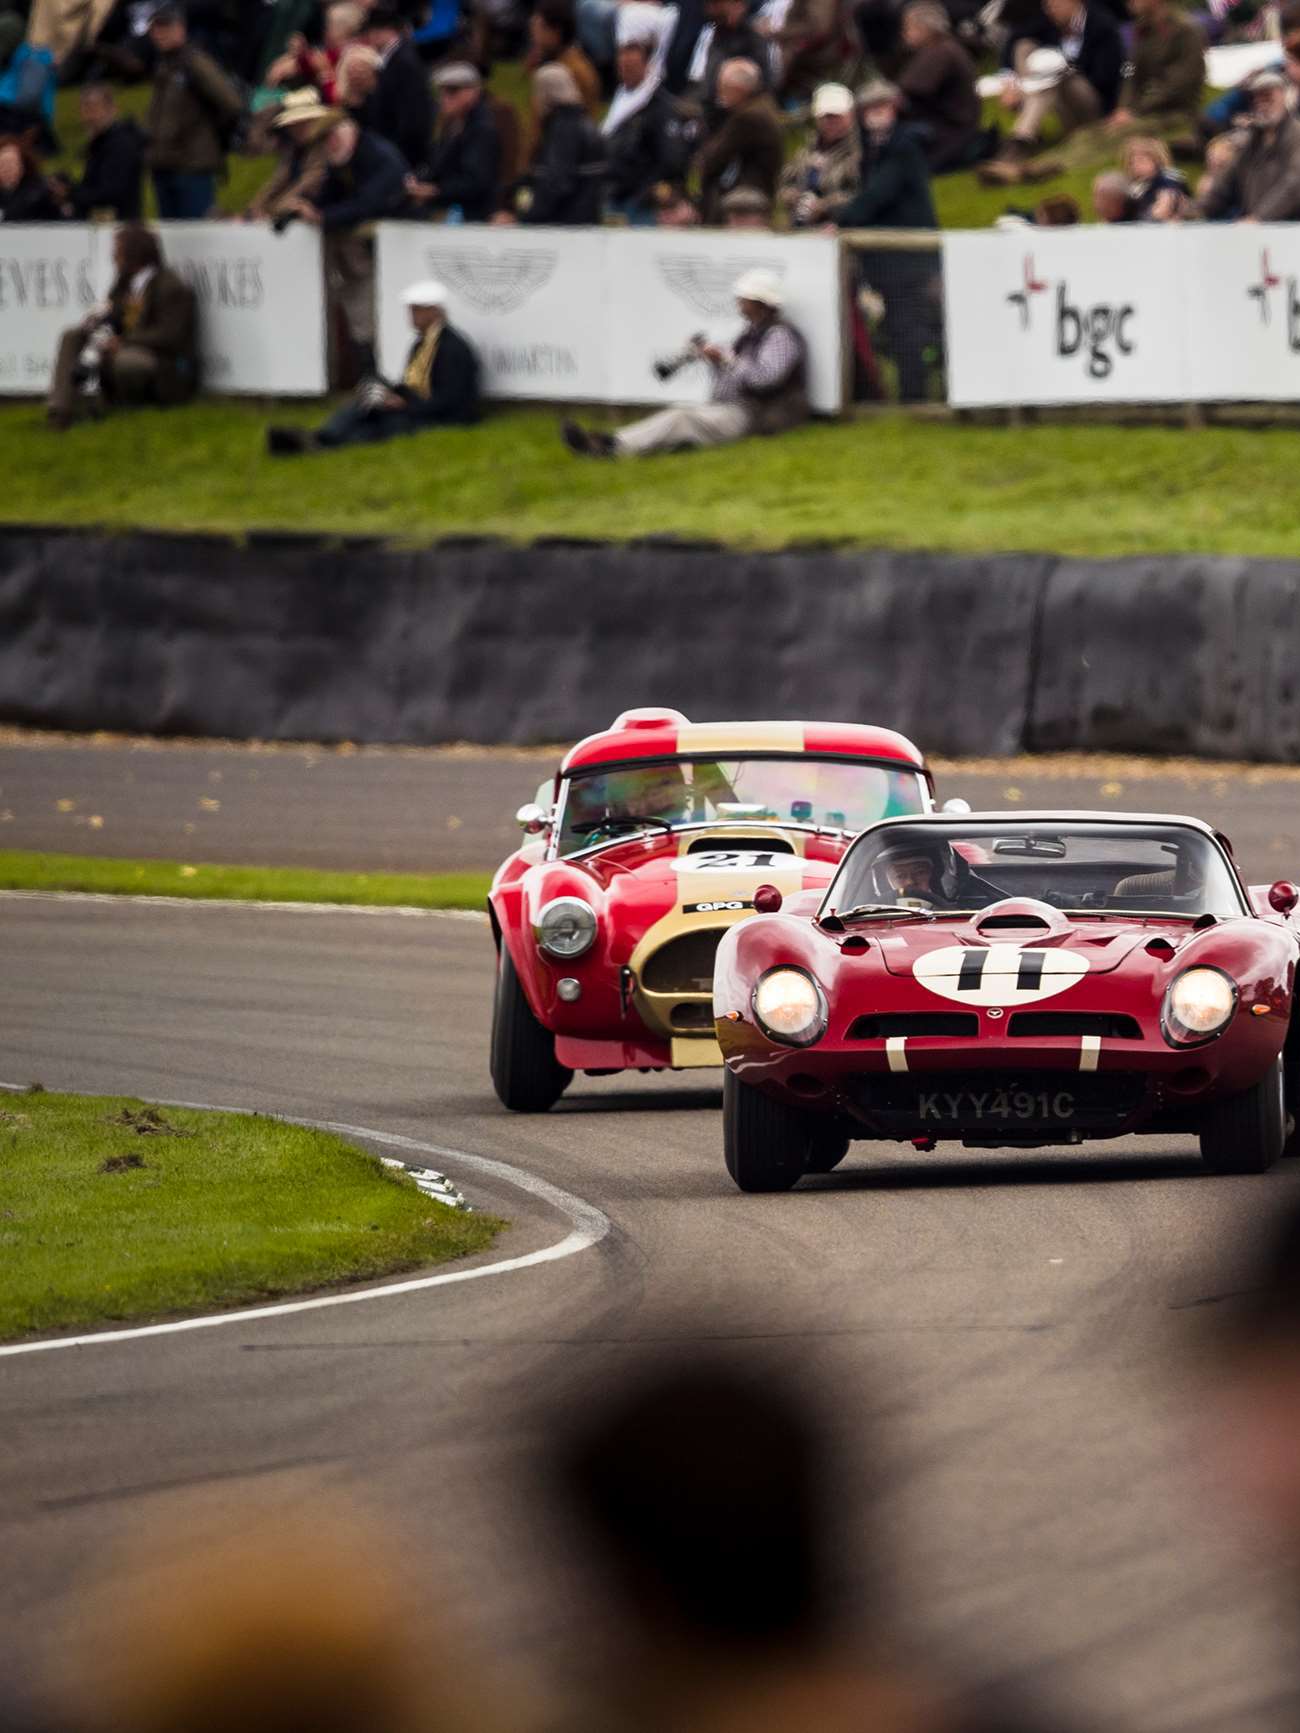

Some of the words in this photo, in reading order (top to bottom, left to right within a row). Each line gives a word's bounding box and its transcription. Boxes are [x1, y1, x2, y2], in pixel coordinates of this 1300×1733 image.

[1057, 279, 1135, 379] bgc
[696, 853, 776, 869] 21
[696, 901, 744, 913] GPG
[957, 950, 1047, 991] 11
[918, 1091, 1075, 1119] KYY491C
